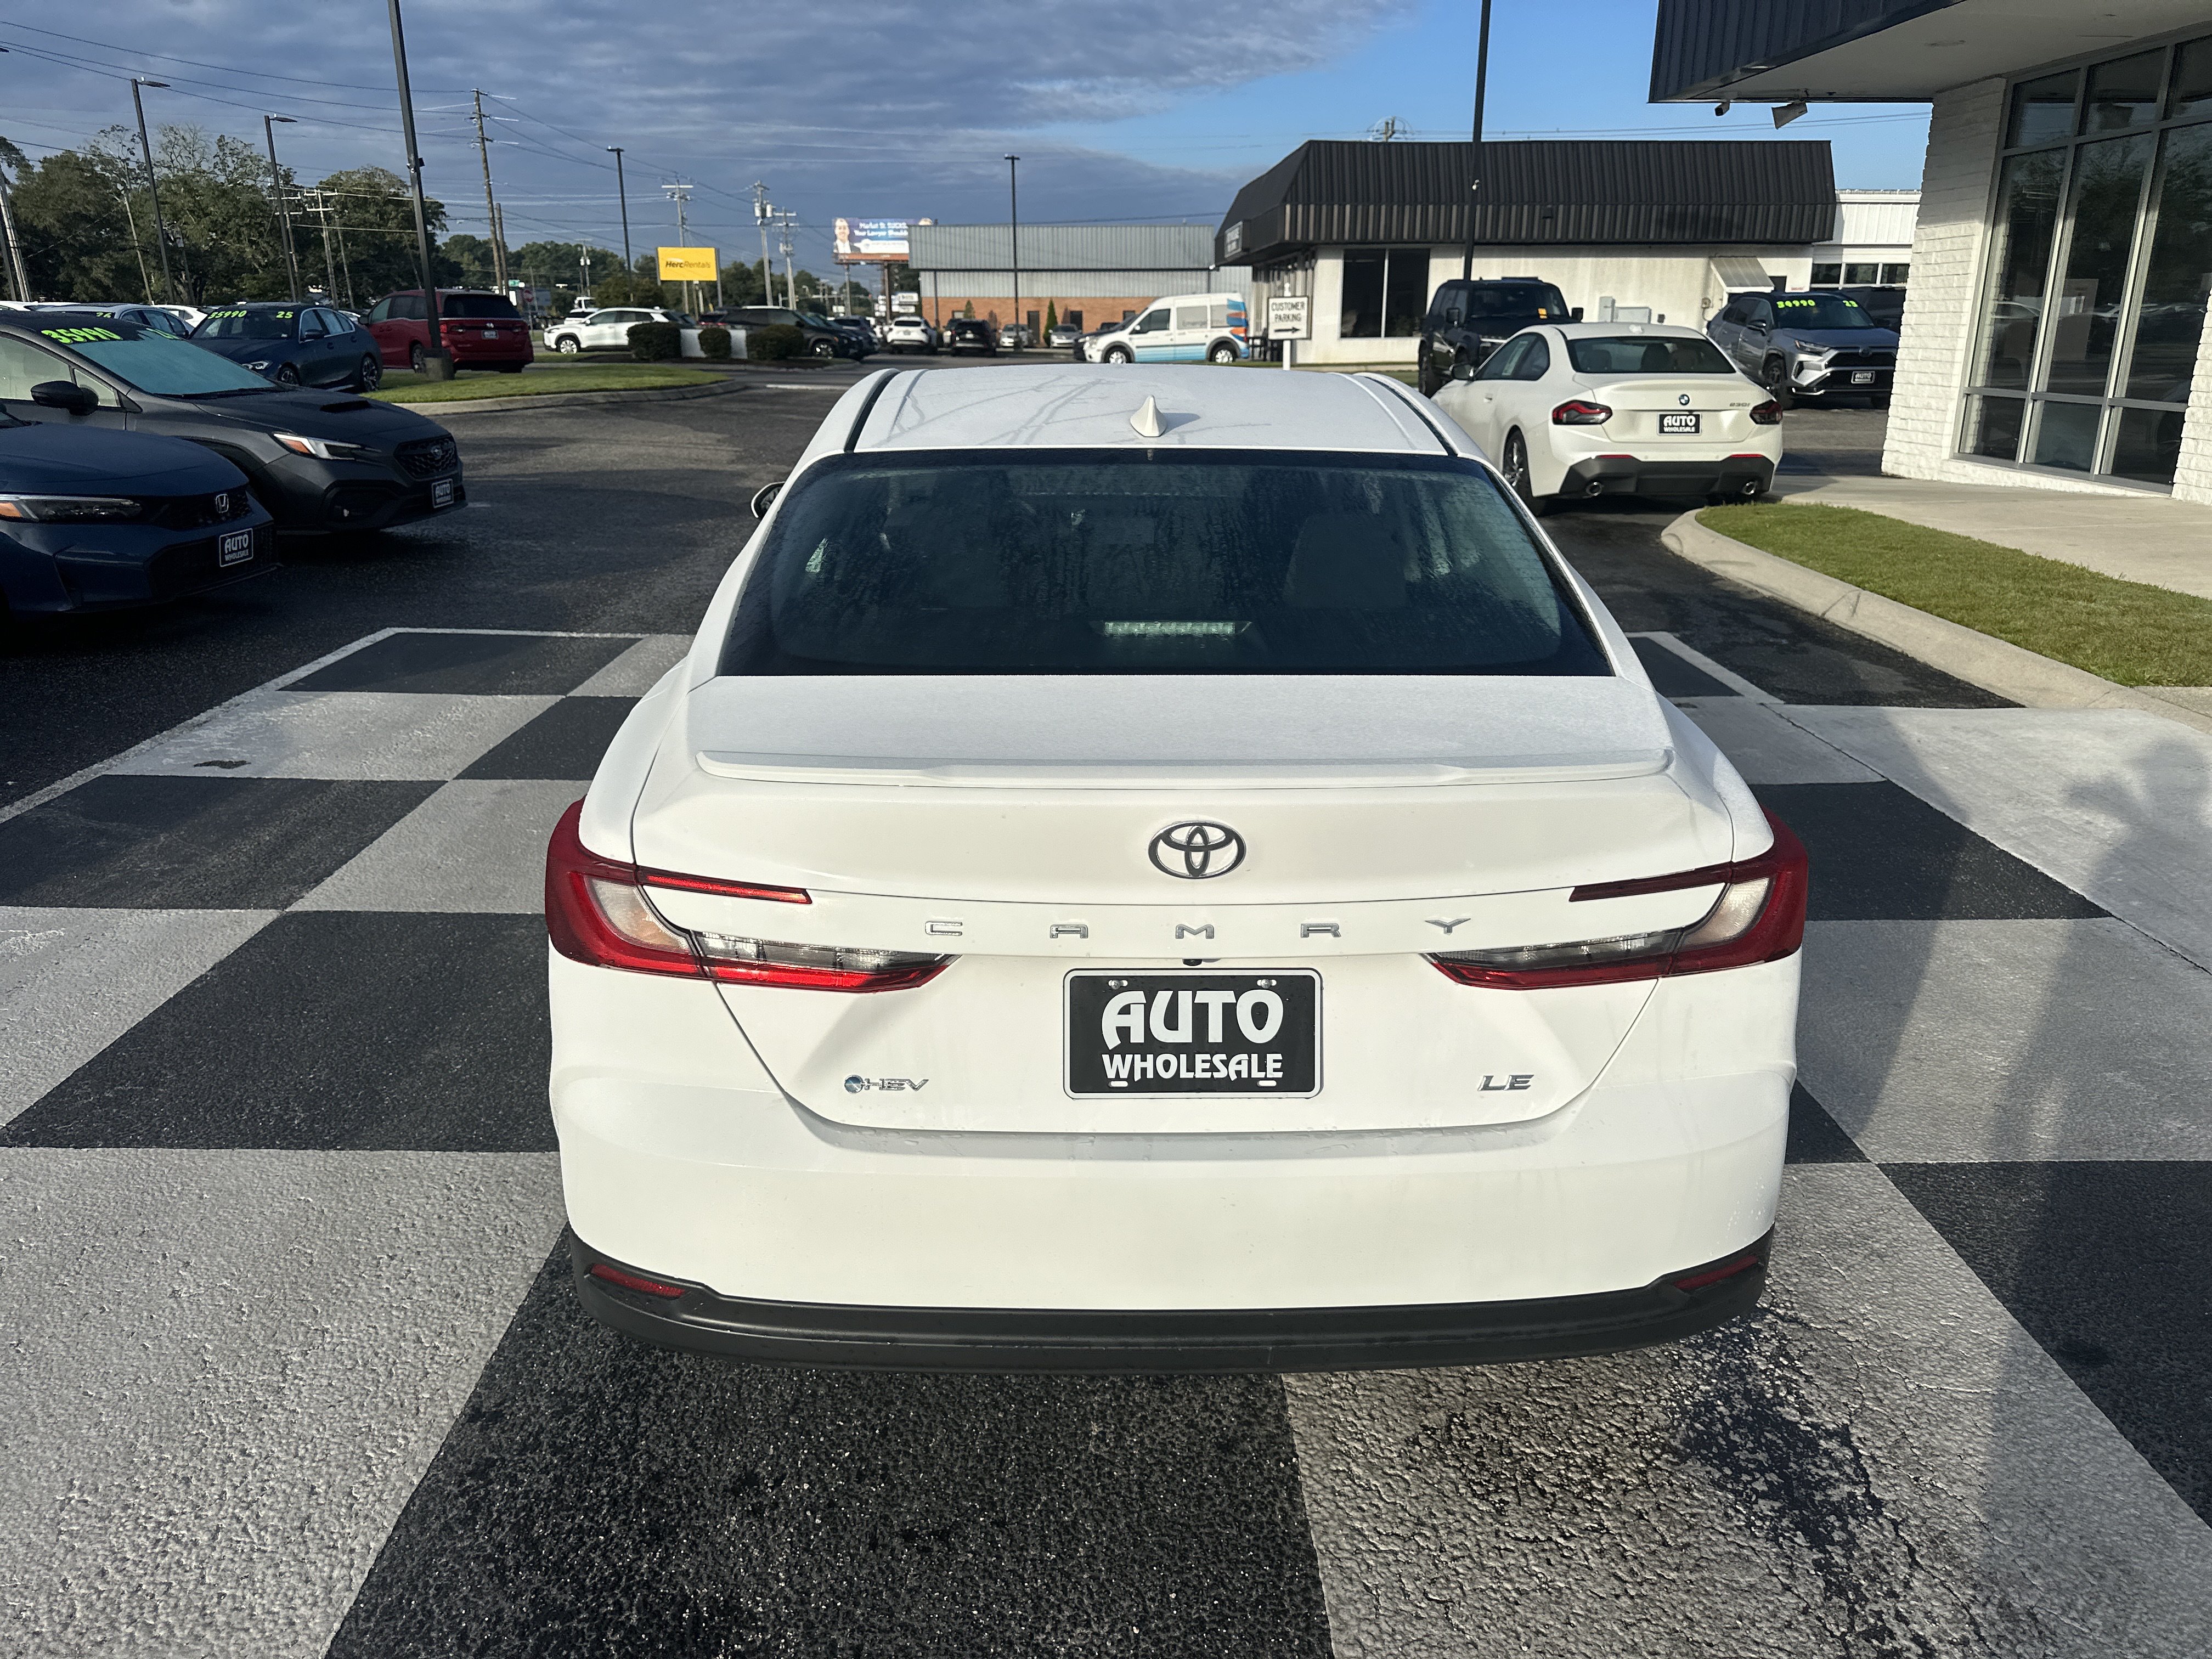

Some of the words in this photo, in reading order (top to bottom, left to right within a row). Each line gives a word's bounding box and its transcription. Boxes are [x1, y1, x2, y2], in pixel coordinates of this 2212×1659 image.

[1271, 301, 1305, 312] CUSTOMER
[1274, 312, 1302, 323] PARKING
[1663, 415, 1696, 427] AUTO
[224, 534, 249, 554] AUTO
[924, 917, 1471, 940] CAMRY
[1102, 989, 1284, 1050] AUTO
[1102, 1053, 1284, 1081] WHOLESALE
[1477, 1074, 1534, 1091] LE
